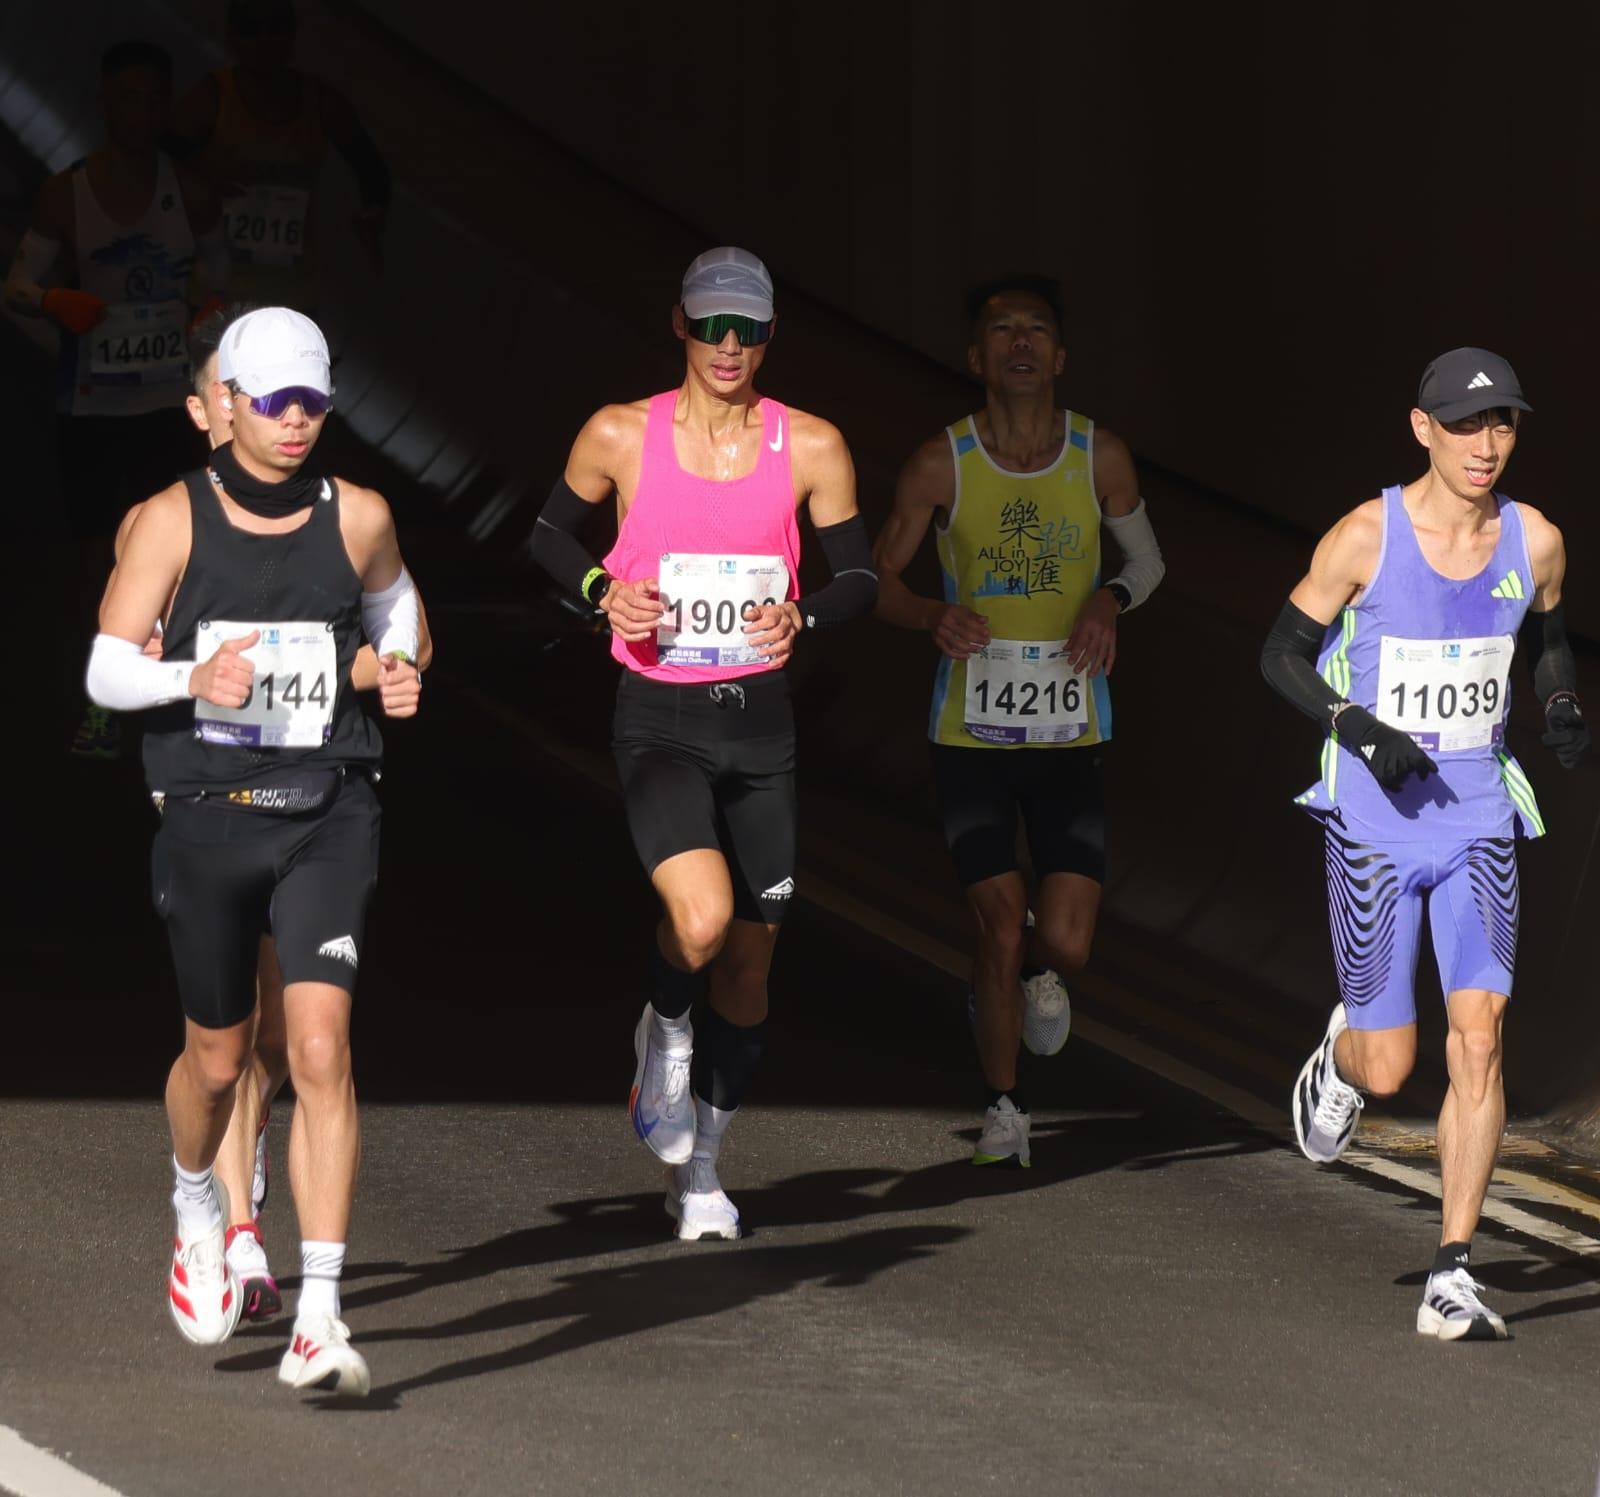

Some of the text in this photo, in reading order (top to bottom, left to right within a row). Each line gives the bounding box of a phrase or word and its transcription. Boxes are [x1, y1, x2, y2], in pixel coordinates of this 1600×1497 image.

[98, 331, 183, 364] 14402
[978, 546, 1026, 560] ALL in
[992, 560, 1025, 574] JOY
[668, 596, 777, 635] 1909
[236, 671, 330, 712] 144
[975, 678, 1081, 716] 14216
[1390, 677, 1500, 720] 11039
